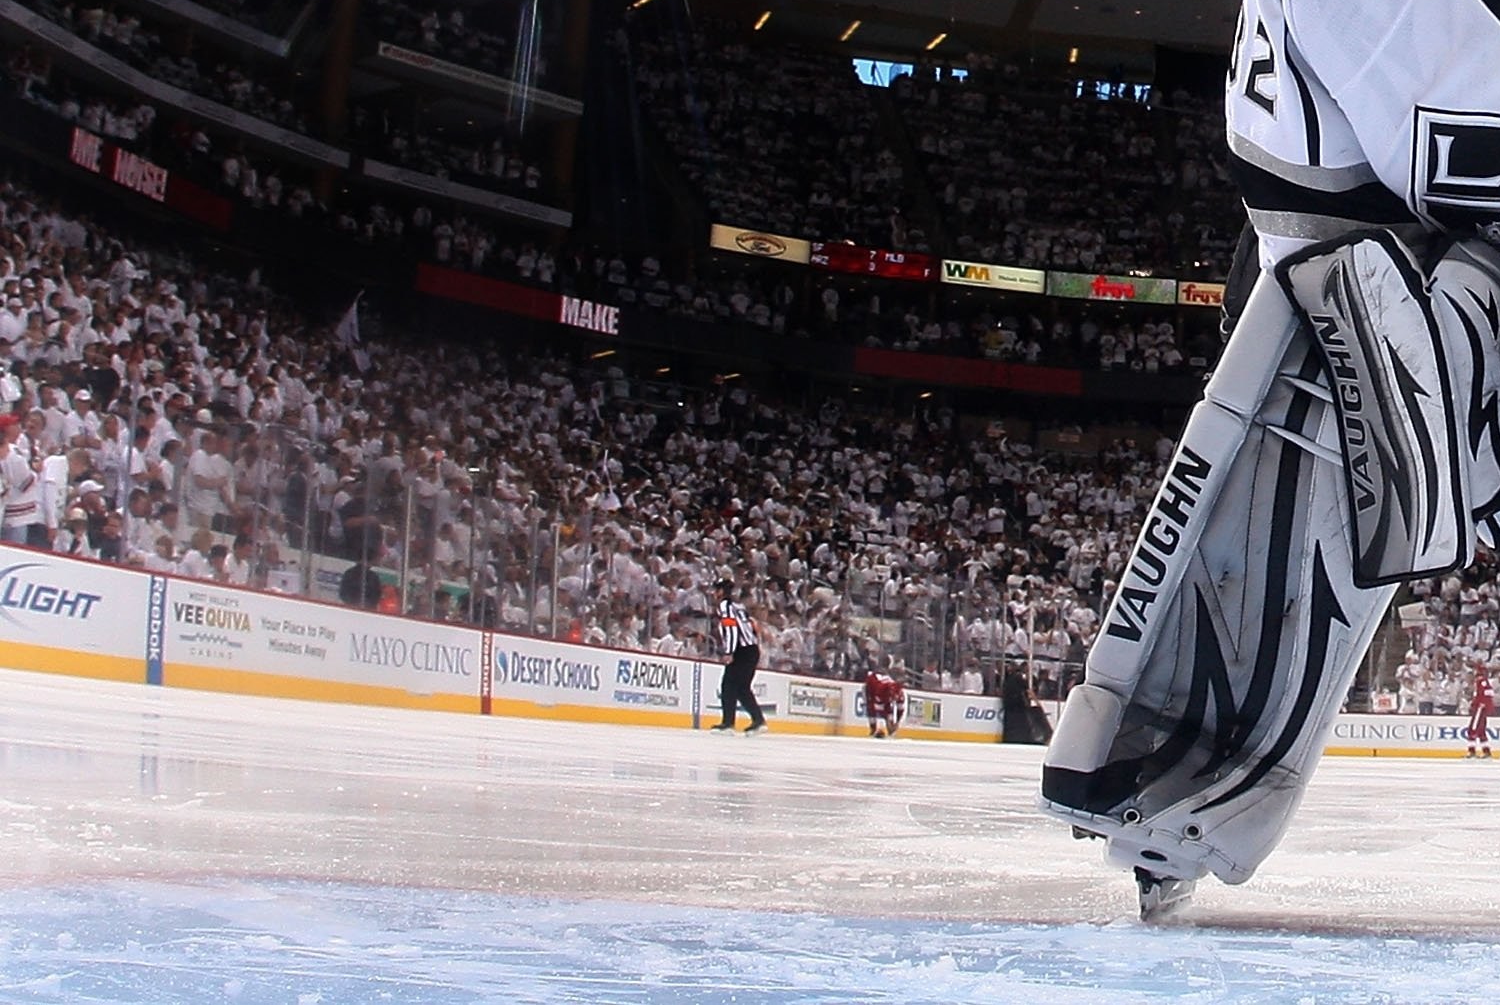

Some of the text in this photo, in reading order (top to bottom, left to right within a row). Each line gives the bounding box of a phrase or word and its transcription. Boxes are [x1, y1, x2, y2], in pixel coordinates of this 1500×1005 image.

[945, 262, 990, 281] WM
[1182, 284, 1222, 305] fry's
[560, 295, 619, 335] MAKE
[1311, 313, 1380, 513] VAUGHN
[1106, 445, 1213, 643] VAUGHN
[2, 577, 102, 619] LIGHT
[174, 602, 251, 631] VEE QUIVA
[260, 617, 337, 643] Your Place to Play
[304, 644, 327, 661] Away
[351, 633, 473, 677] MAYO CLINIC
[510, 651, 600, 691] DESERT SCHOOLS
[1334, 724, 1406, 739] CLINIC
